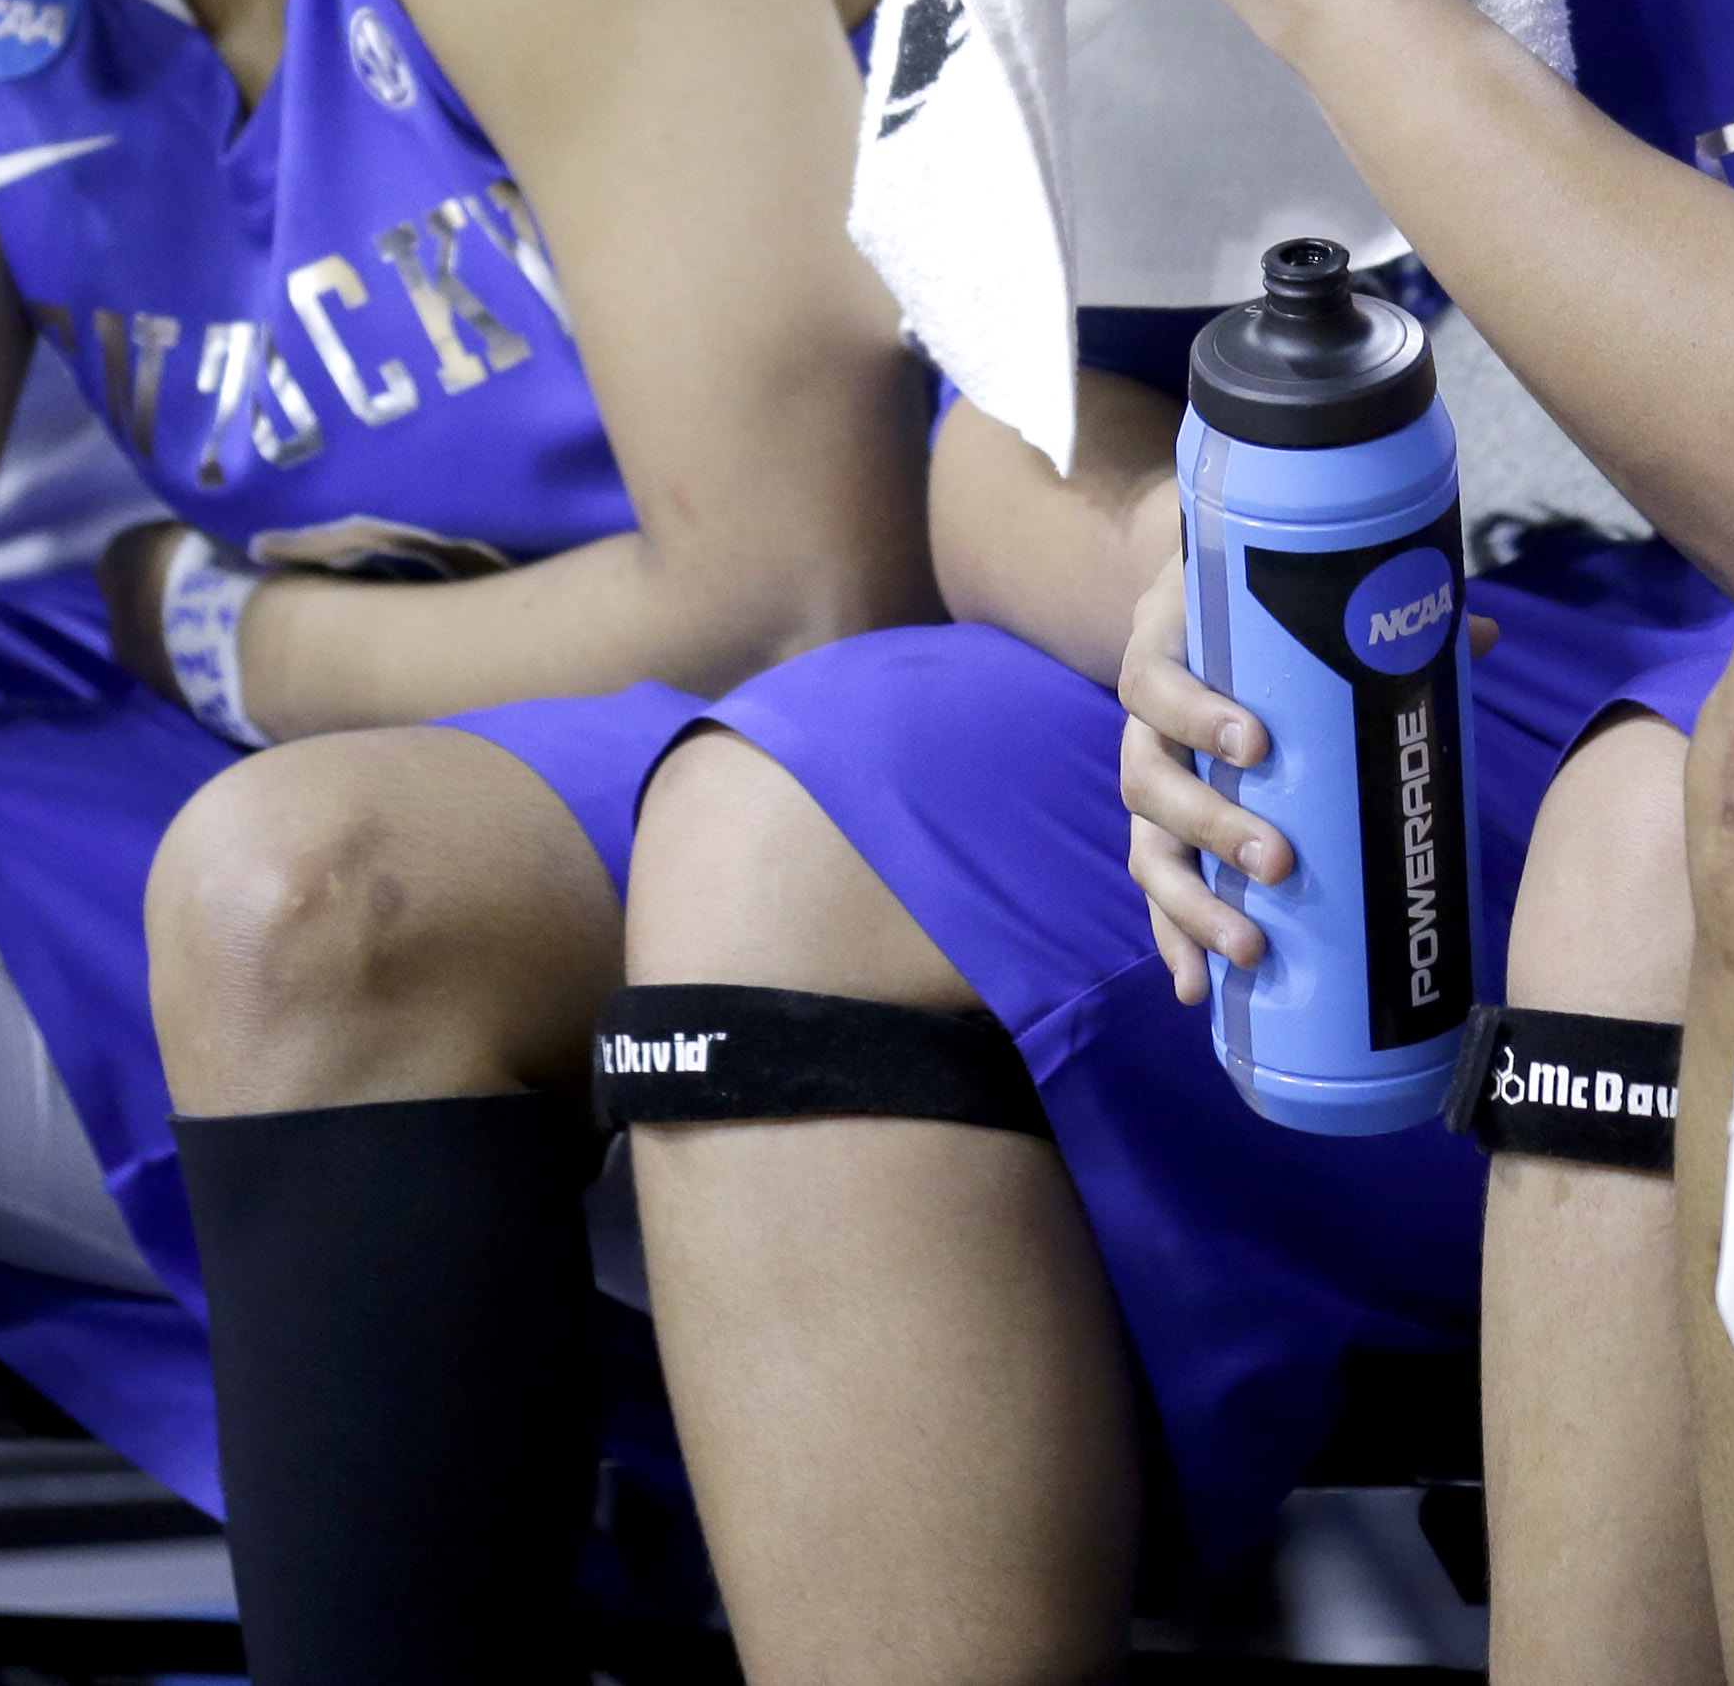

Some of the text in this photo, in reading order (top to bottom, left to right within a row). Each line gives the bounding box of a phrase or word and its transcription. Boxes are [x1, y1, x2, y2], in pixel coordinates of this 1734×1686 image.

[1368, 582, 1453, 646] NCAA
[1397, 710, 1441, 1007] POWERADE
[1527, 1060, 1679, 1119] McDav
